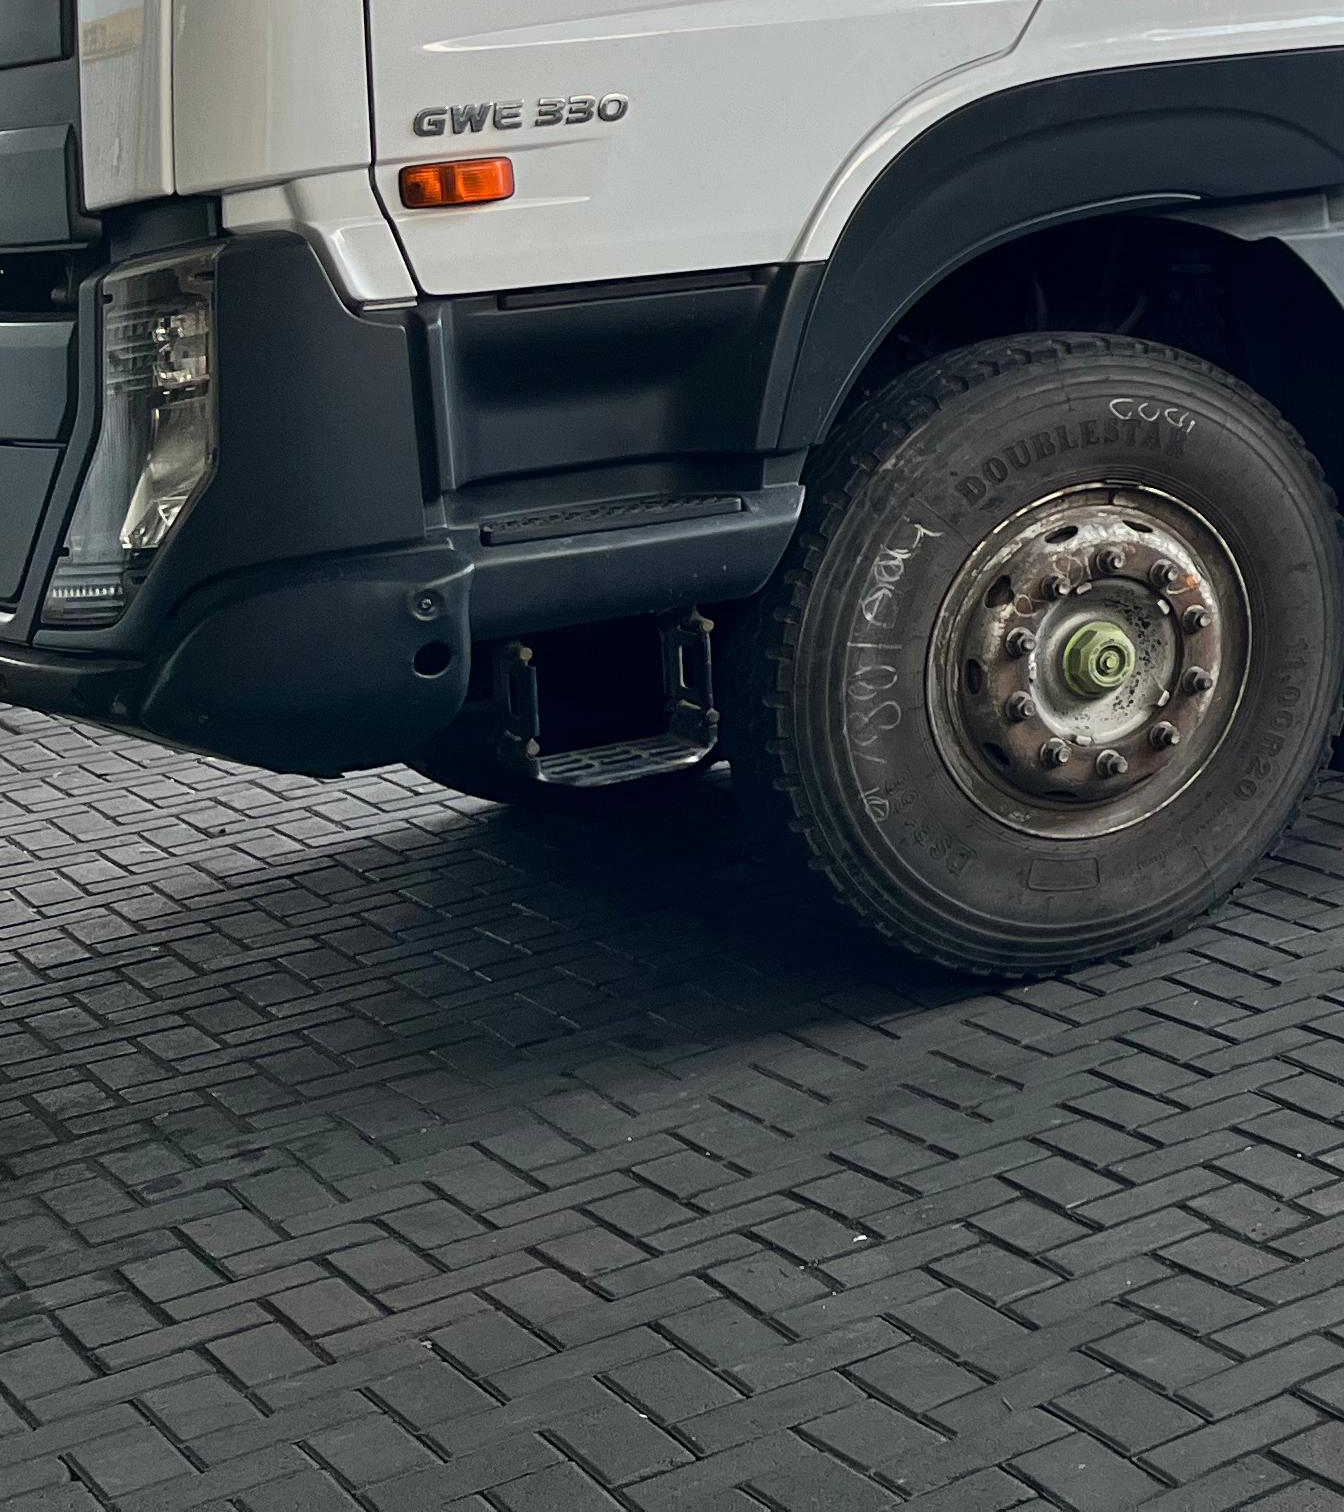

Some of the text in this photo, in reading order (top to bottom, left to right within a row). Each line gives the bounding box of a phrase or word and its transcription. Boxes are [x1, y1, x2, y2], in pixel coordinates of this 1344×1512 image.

[411, 92, 630, 139] GWE 330
[954, 417, 1188, 507] DOUBLESTAR
[1234, 634, 1309, 802] 11.00R20
